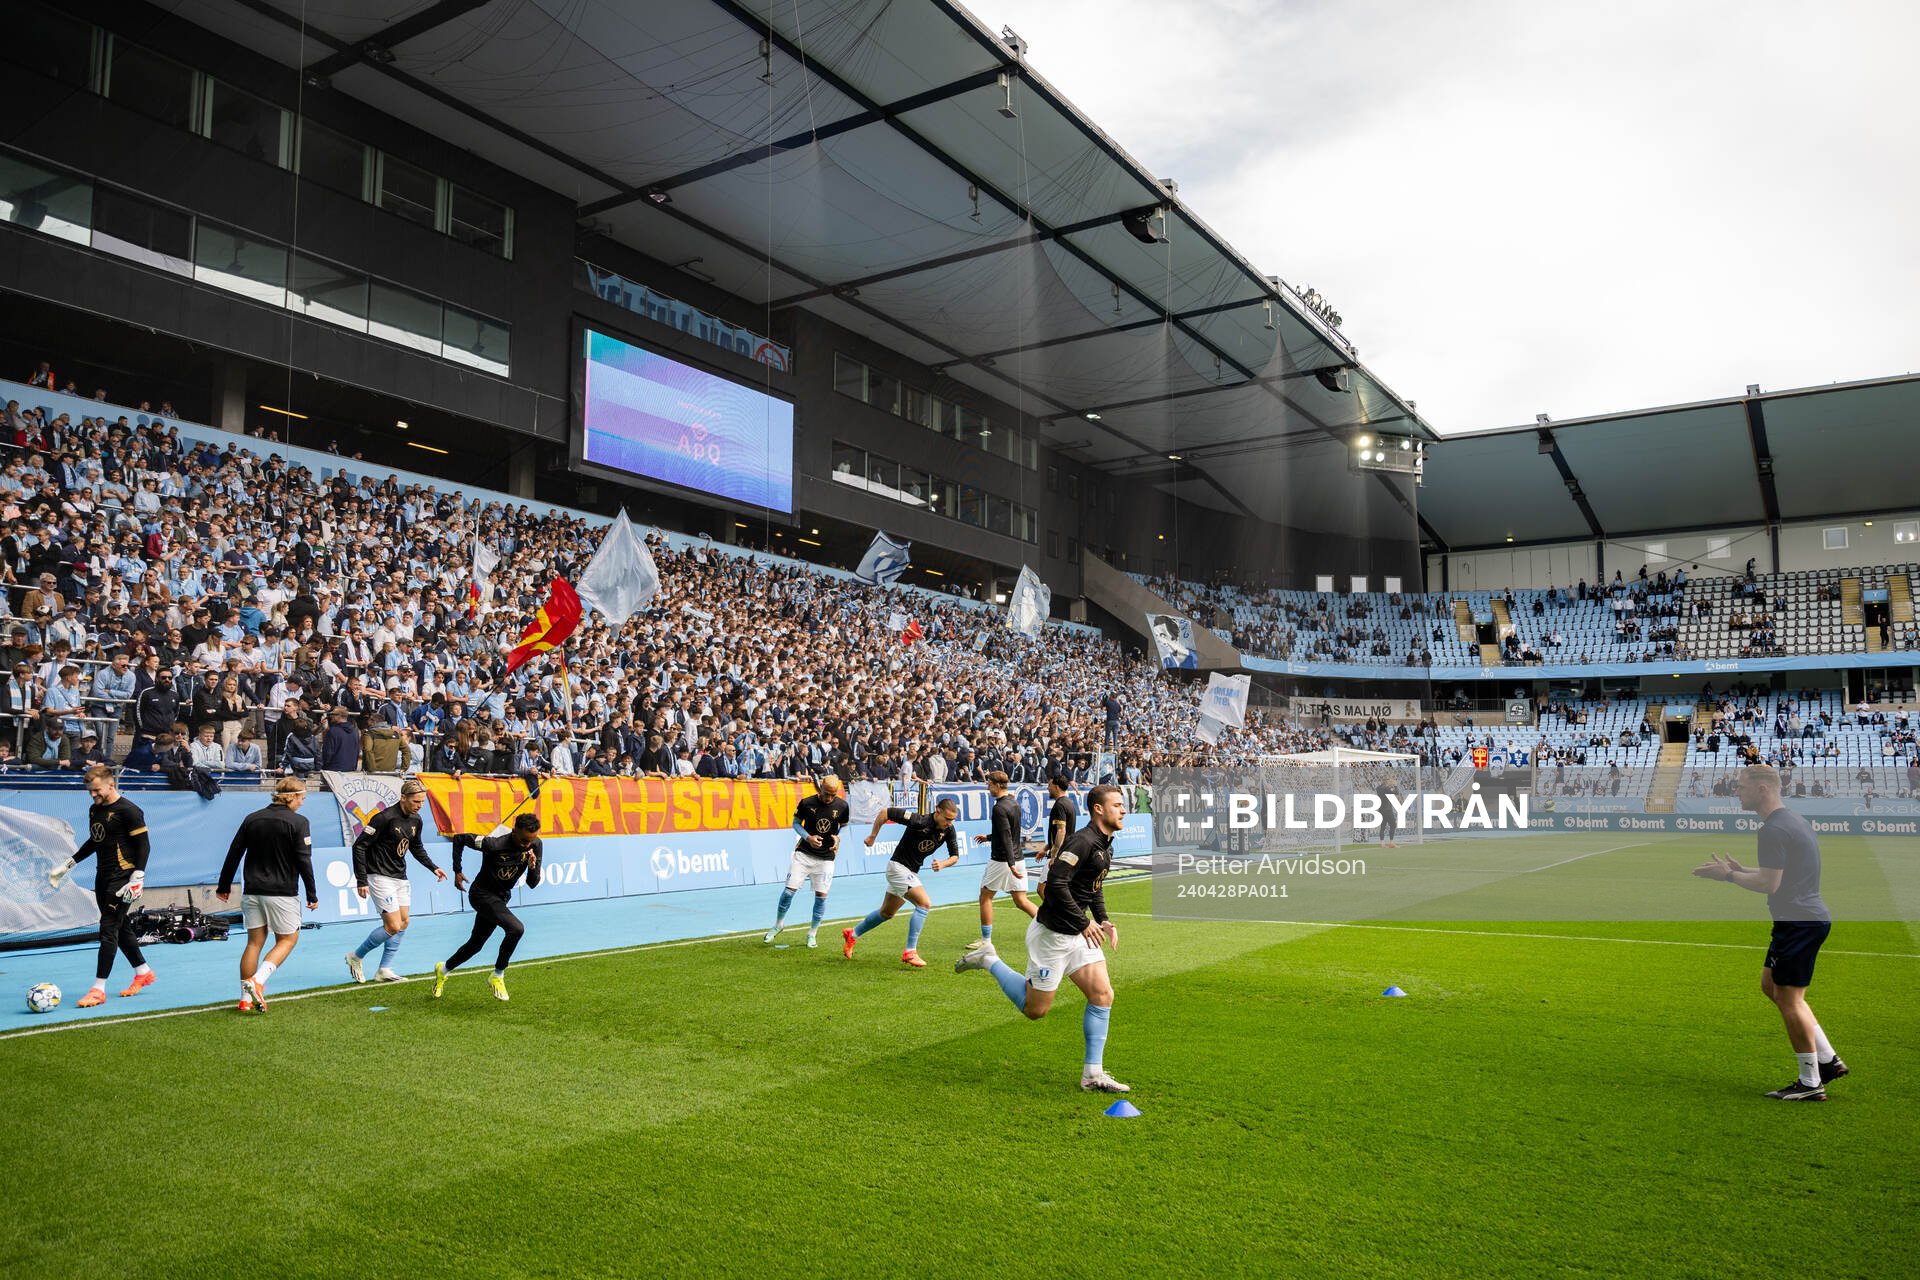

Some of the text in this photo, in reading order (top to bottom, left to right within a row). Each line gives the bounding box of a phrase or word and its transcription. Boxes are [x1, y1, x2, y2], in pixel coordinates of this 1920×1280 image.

[428, 775, 818, 836] TERRA SCANI
[1528, 817, 1554, 828] emt
[1576, 816, 1608, 828] bemt
[1632, 816, 1665, 829] bemt
[1689, 818, 1724, 830] bemt
[1749, 819, 1764, 829] be
[1812, 820, 1850, 832] bemt
[1877, 820, 1917, 833] bemt
[678, 848, 730, 874] bemt
